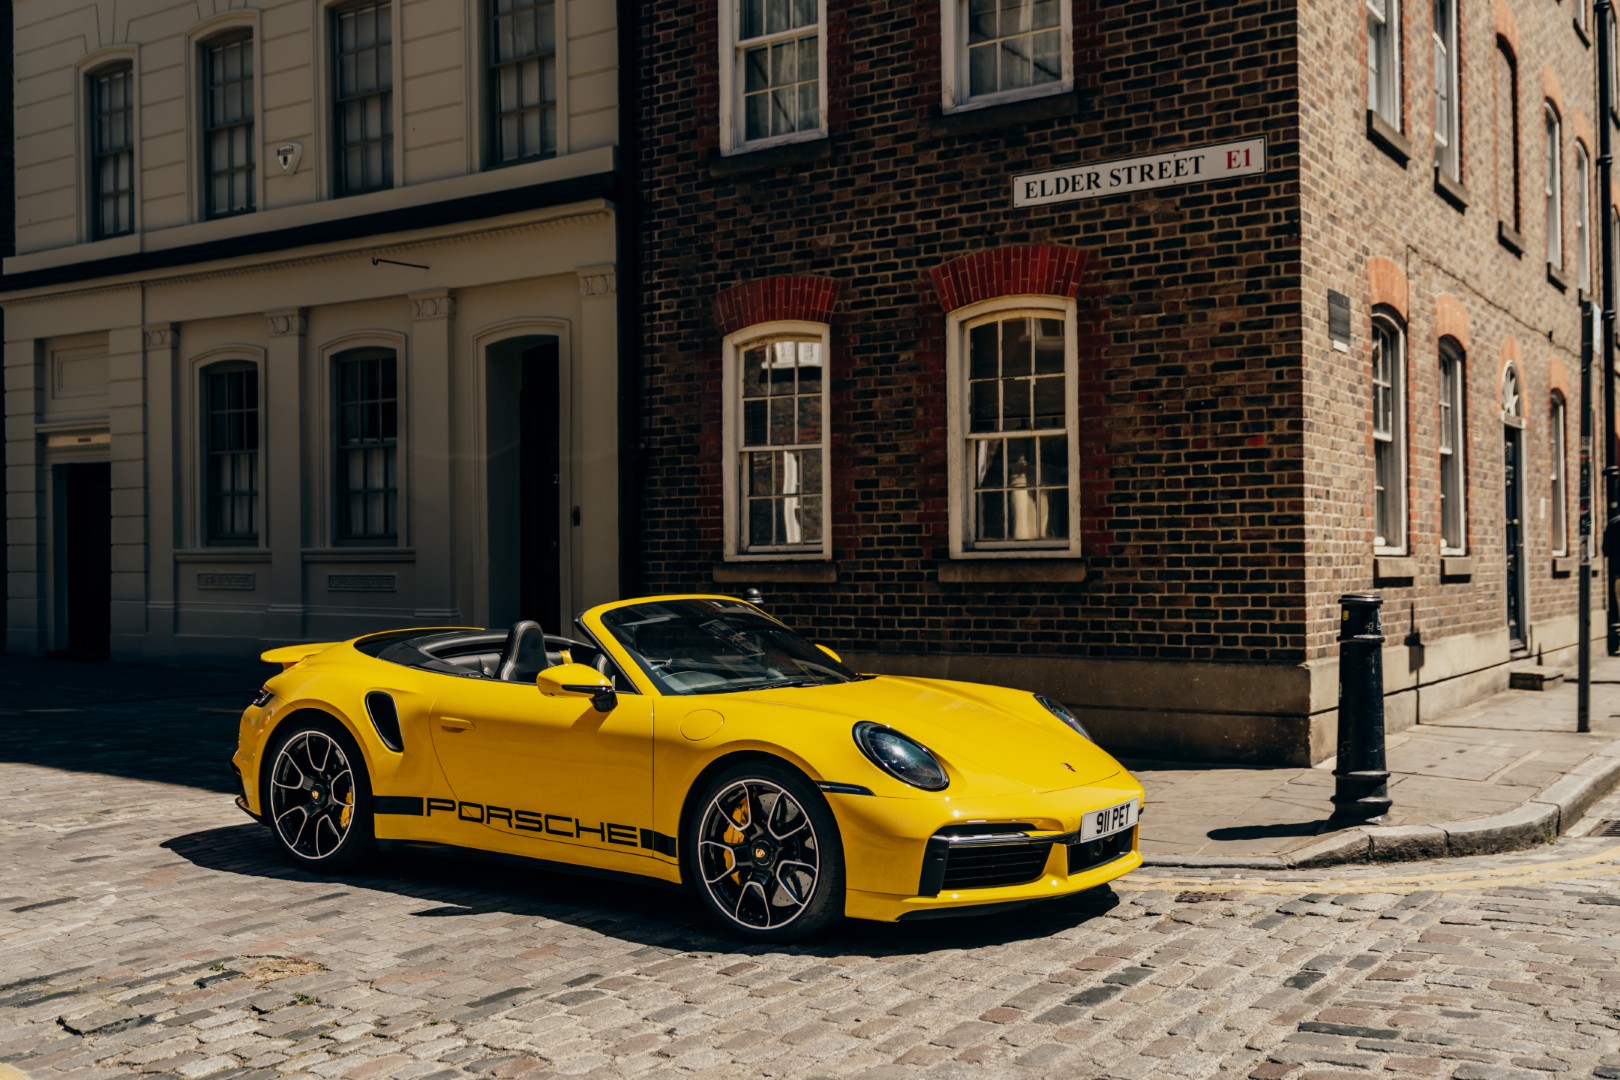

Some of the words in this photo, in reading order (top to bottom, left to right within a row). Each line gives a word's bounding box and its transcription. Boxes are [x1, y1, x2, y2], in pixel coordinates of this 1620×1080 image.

[1024, 171, 1102, 200] ELDER
[1109, 155, 1205, 188] STREET
[1226, 148, 1253, 170] E1
[426, 797, 638, 847] PORSCHE
[1096, 810, 1110, 834] 911
[1112, 803, 1130, 830] PET
